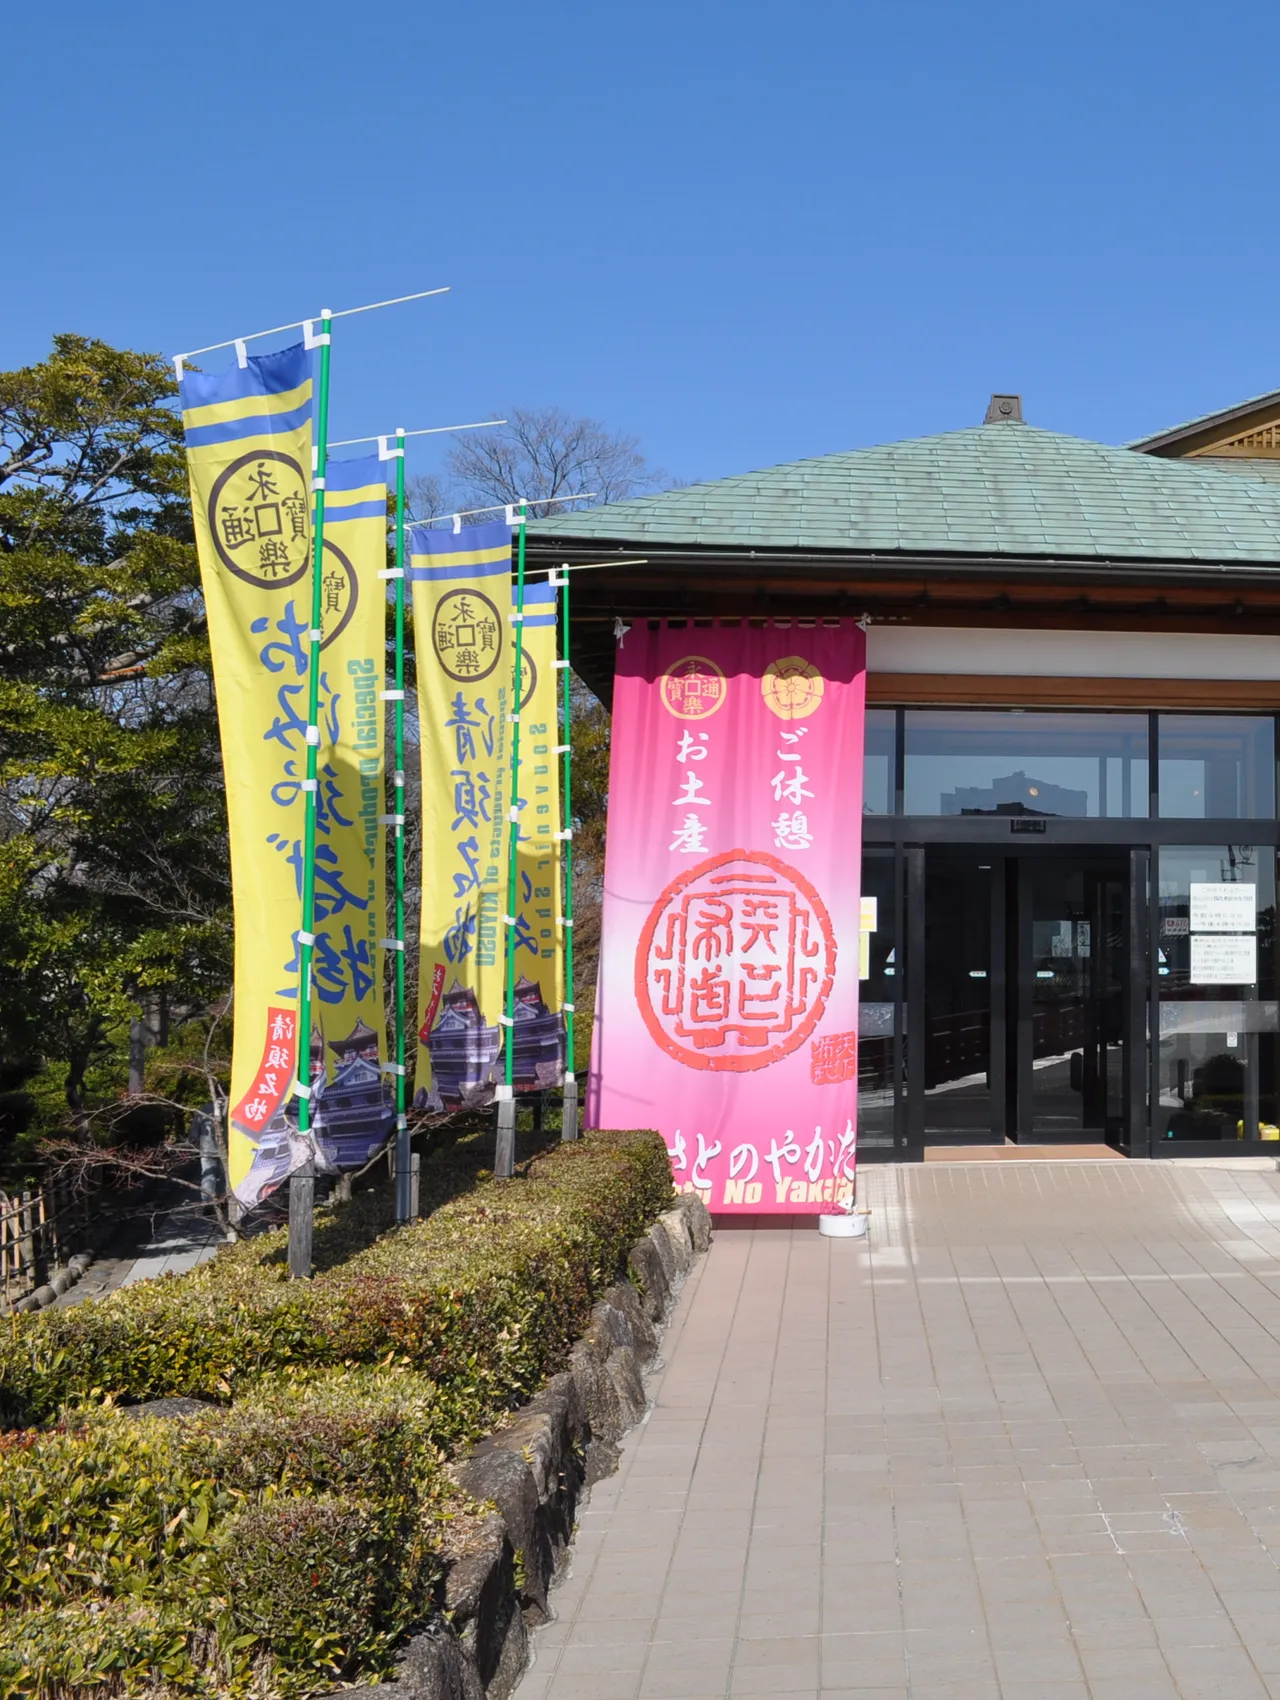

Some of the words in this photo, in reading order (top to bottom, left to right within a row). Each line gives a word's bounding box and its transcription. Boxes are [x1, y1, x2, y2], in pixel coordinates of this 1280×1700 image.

[668, 729, 712, 854] お土産
[770, 726, 815, 850] ご休憩
[723, 1178, 763, 1205] No
